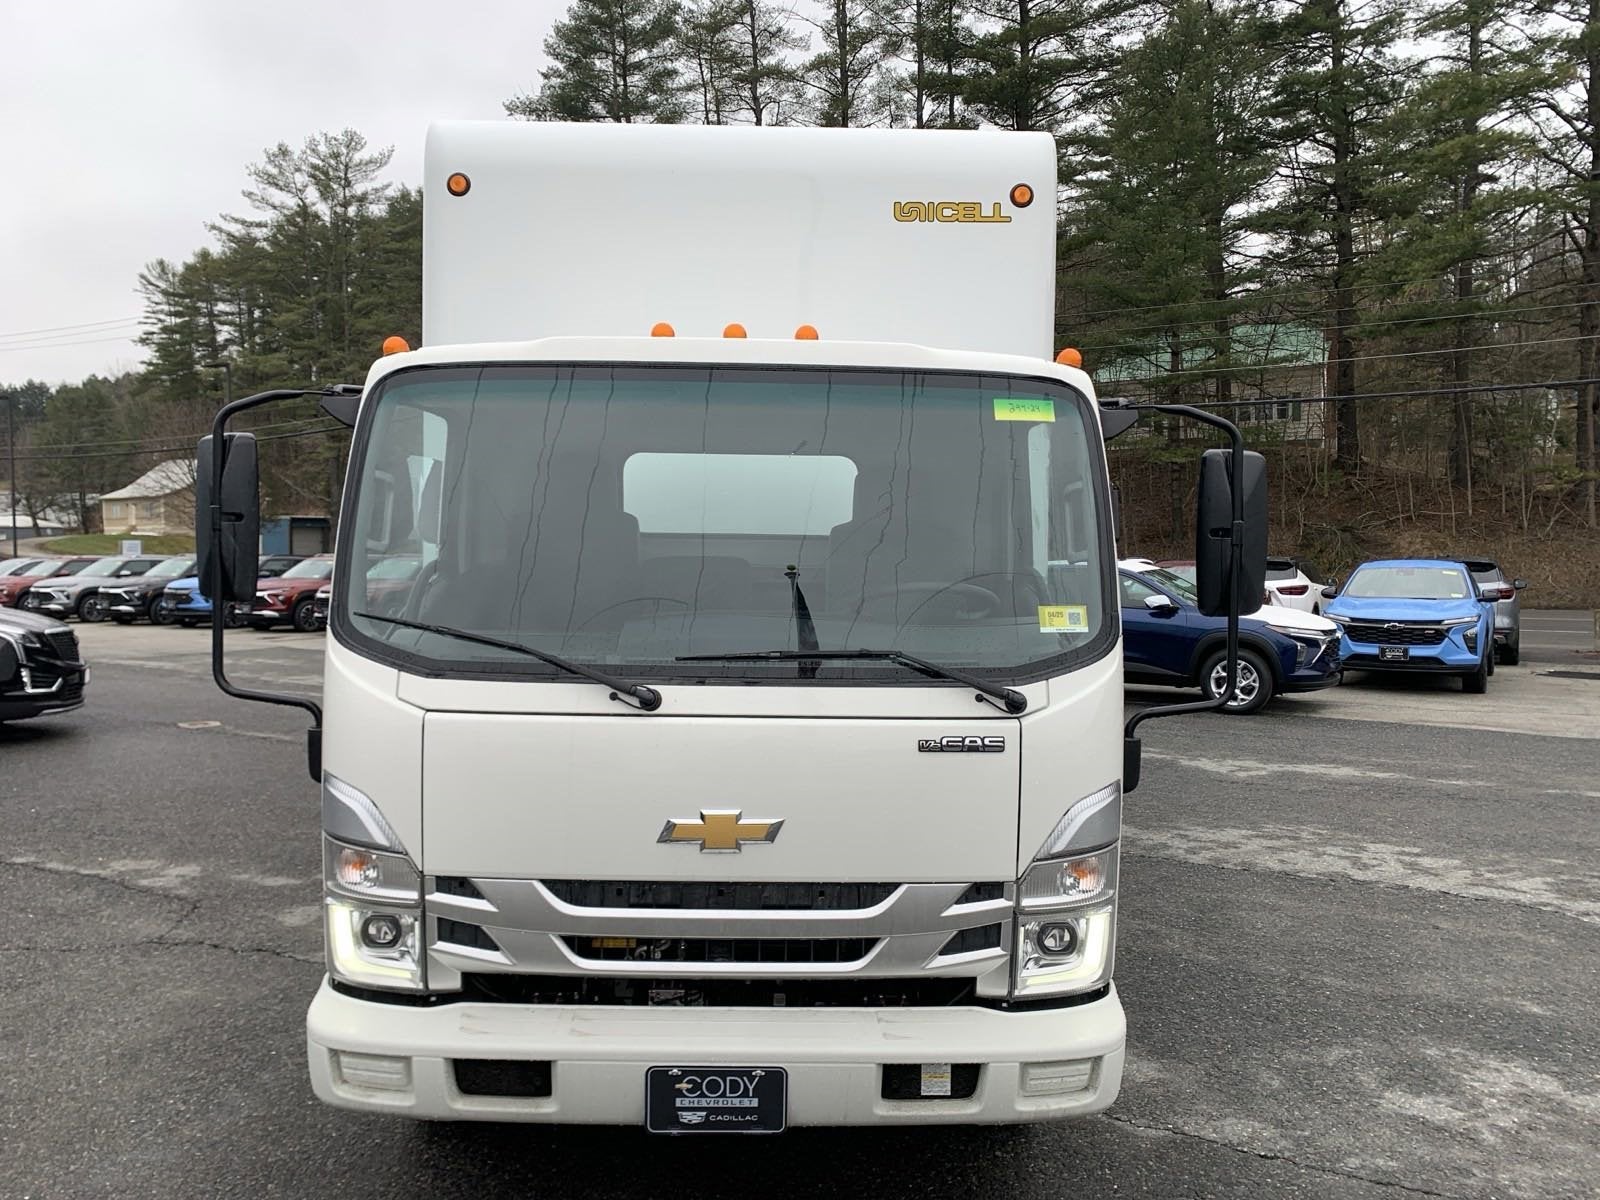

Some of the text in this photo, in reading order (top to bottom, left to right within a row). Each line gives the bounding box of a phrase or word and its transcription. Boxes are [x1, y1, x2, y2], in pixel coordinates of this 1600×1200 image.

[893, 201, 1012, 223] UNICELL
[941, 736, 1005, 752] GAS
[682, 1076, 760, 1097] CODY
